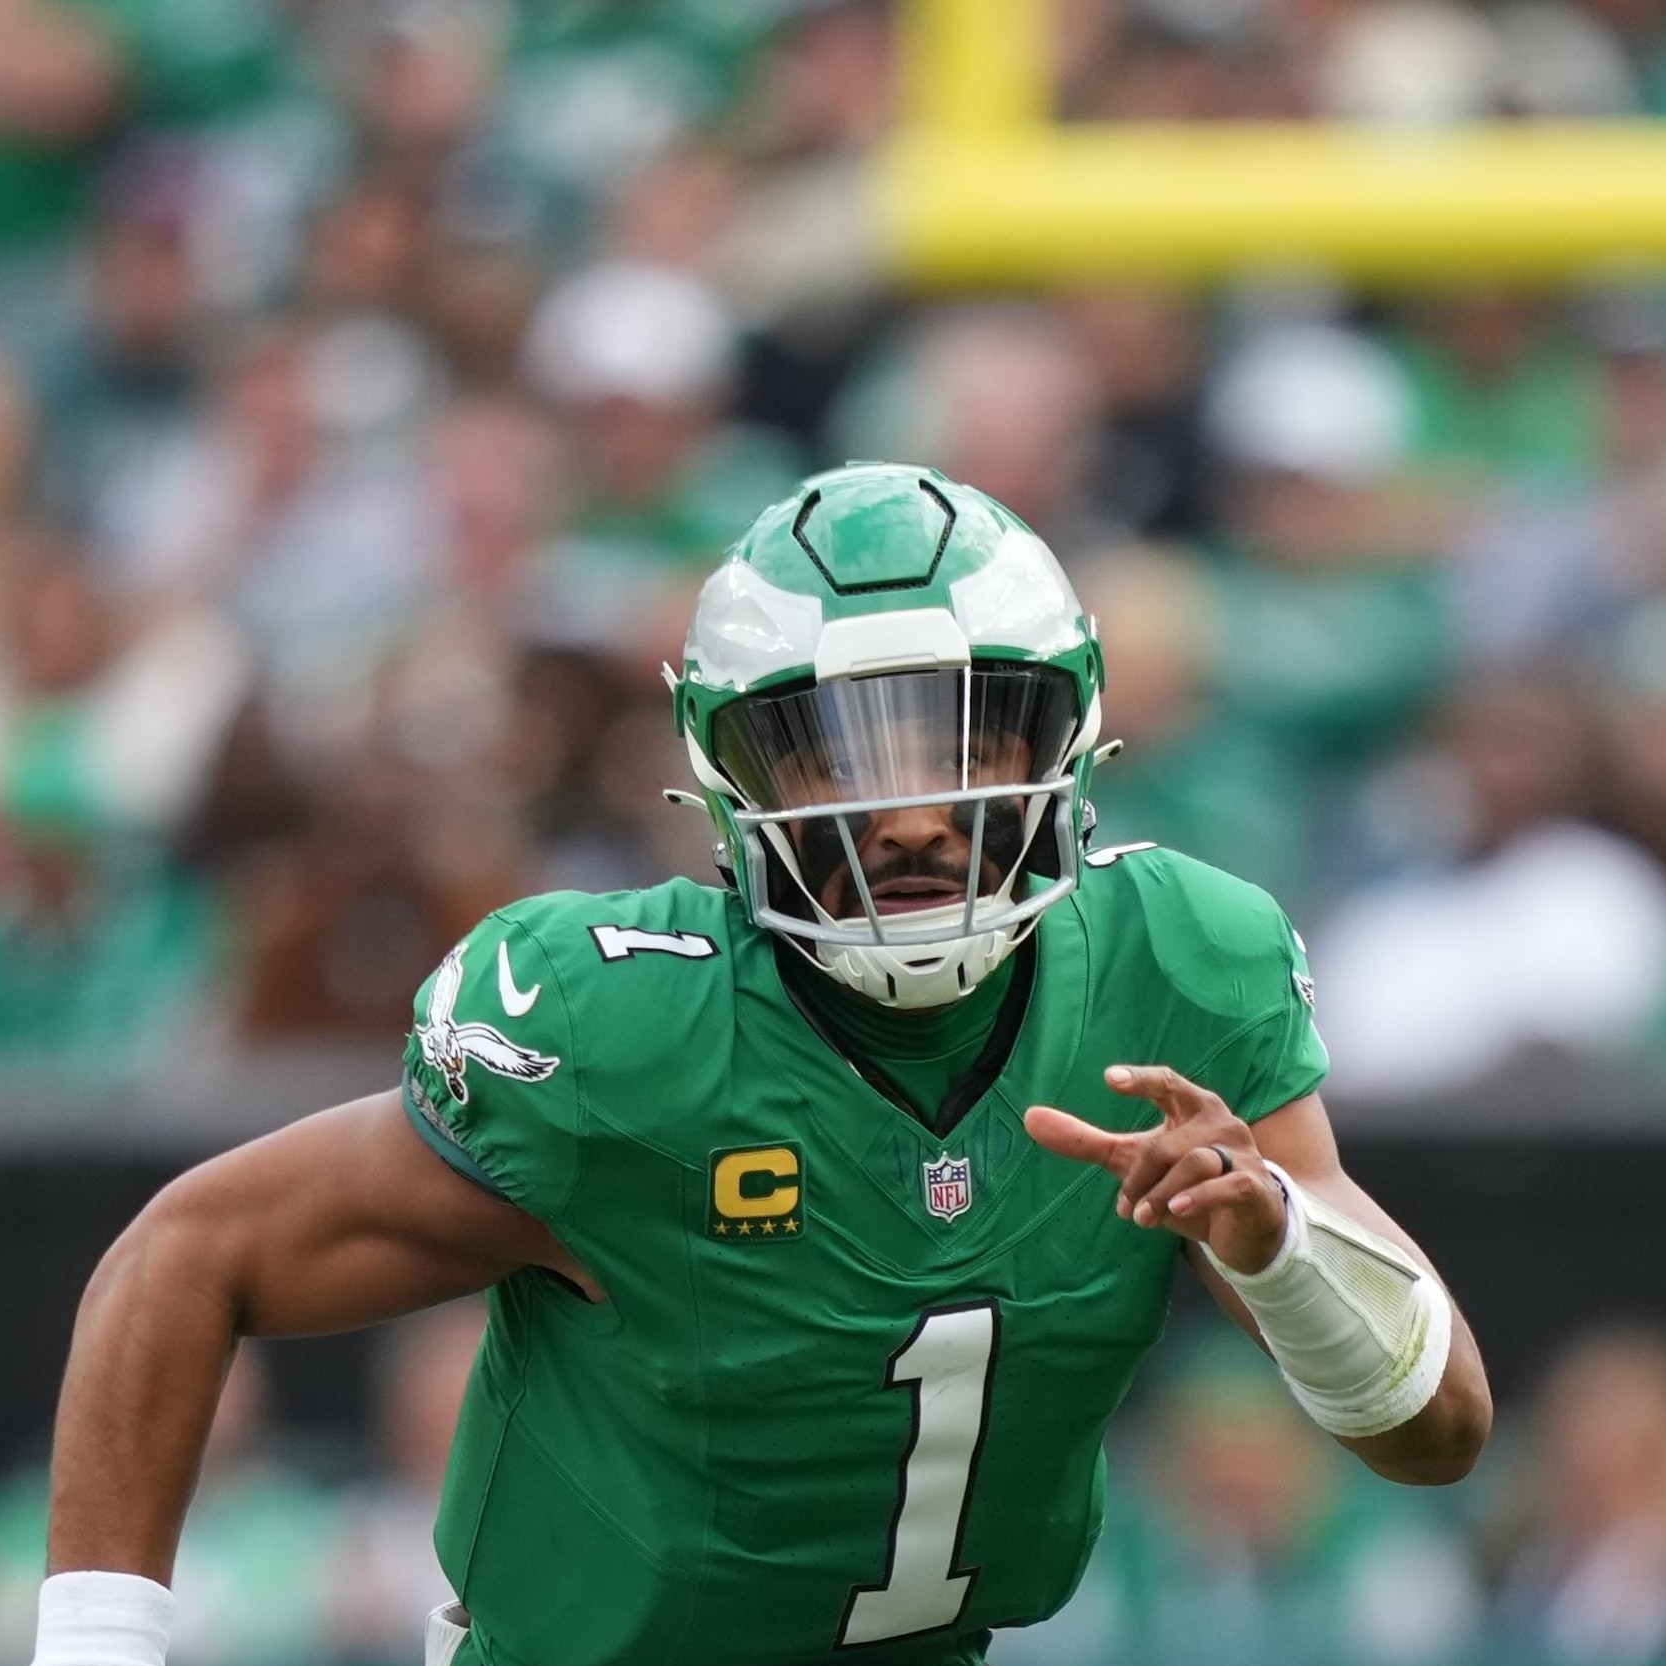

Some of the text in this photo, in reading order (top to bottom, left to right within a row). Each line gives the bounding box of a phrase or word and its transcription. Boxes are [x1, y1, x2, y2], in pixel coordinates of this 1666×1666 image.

[587, 924, 722, 963] 1
[715, 1149, 798, 1218] C
[933, 1184, 965, 1210] NFL
[832, 1298, 1002, 1651] 1
